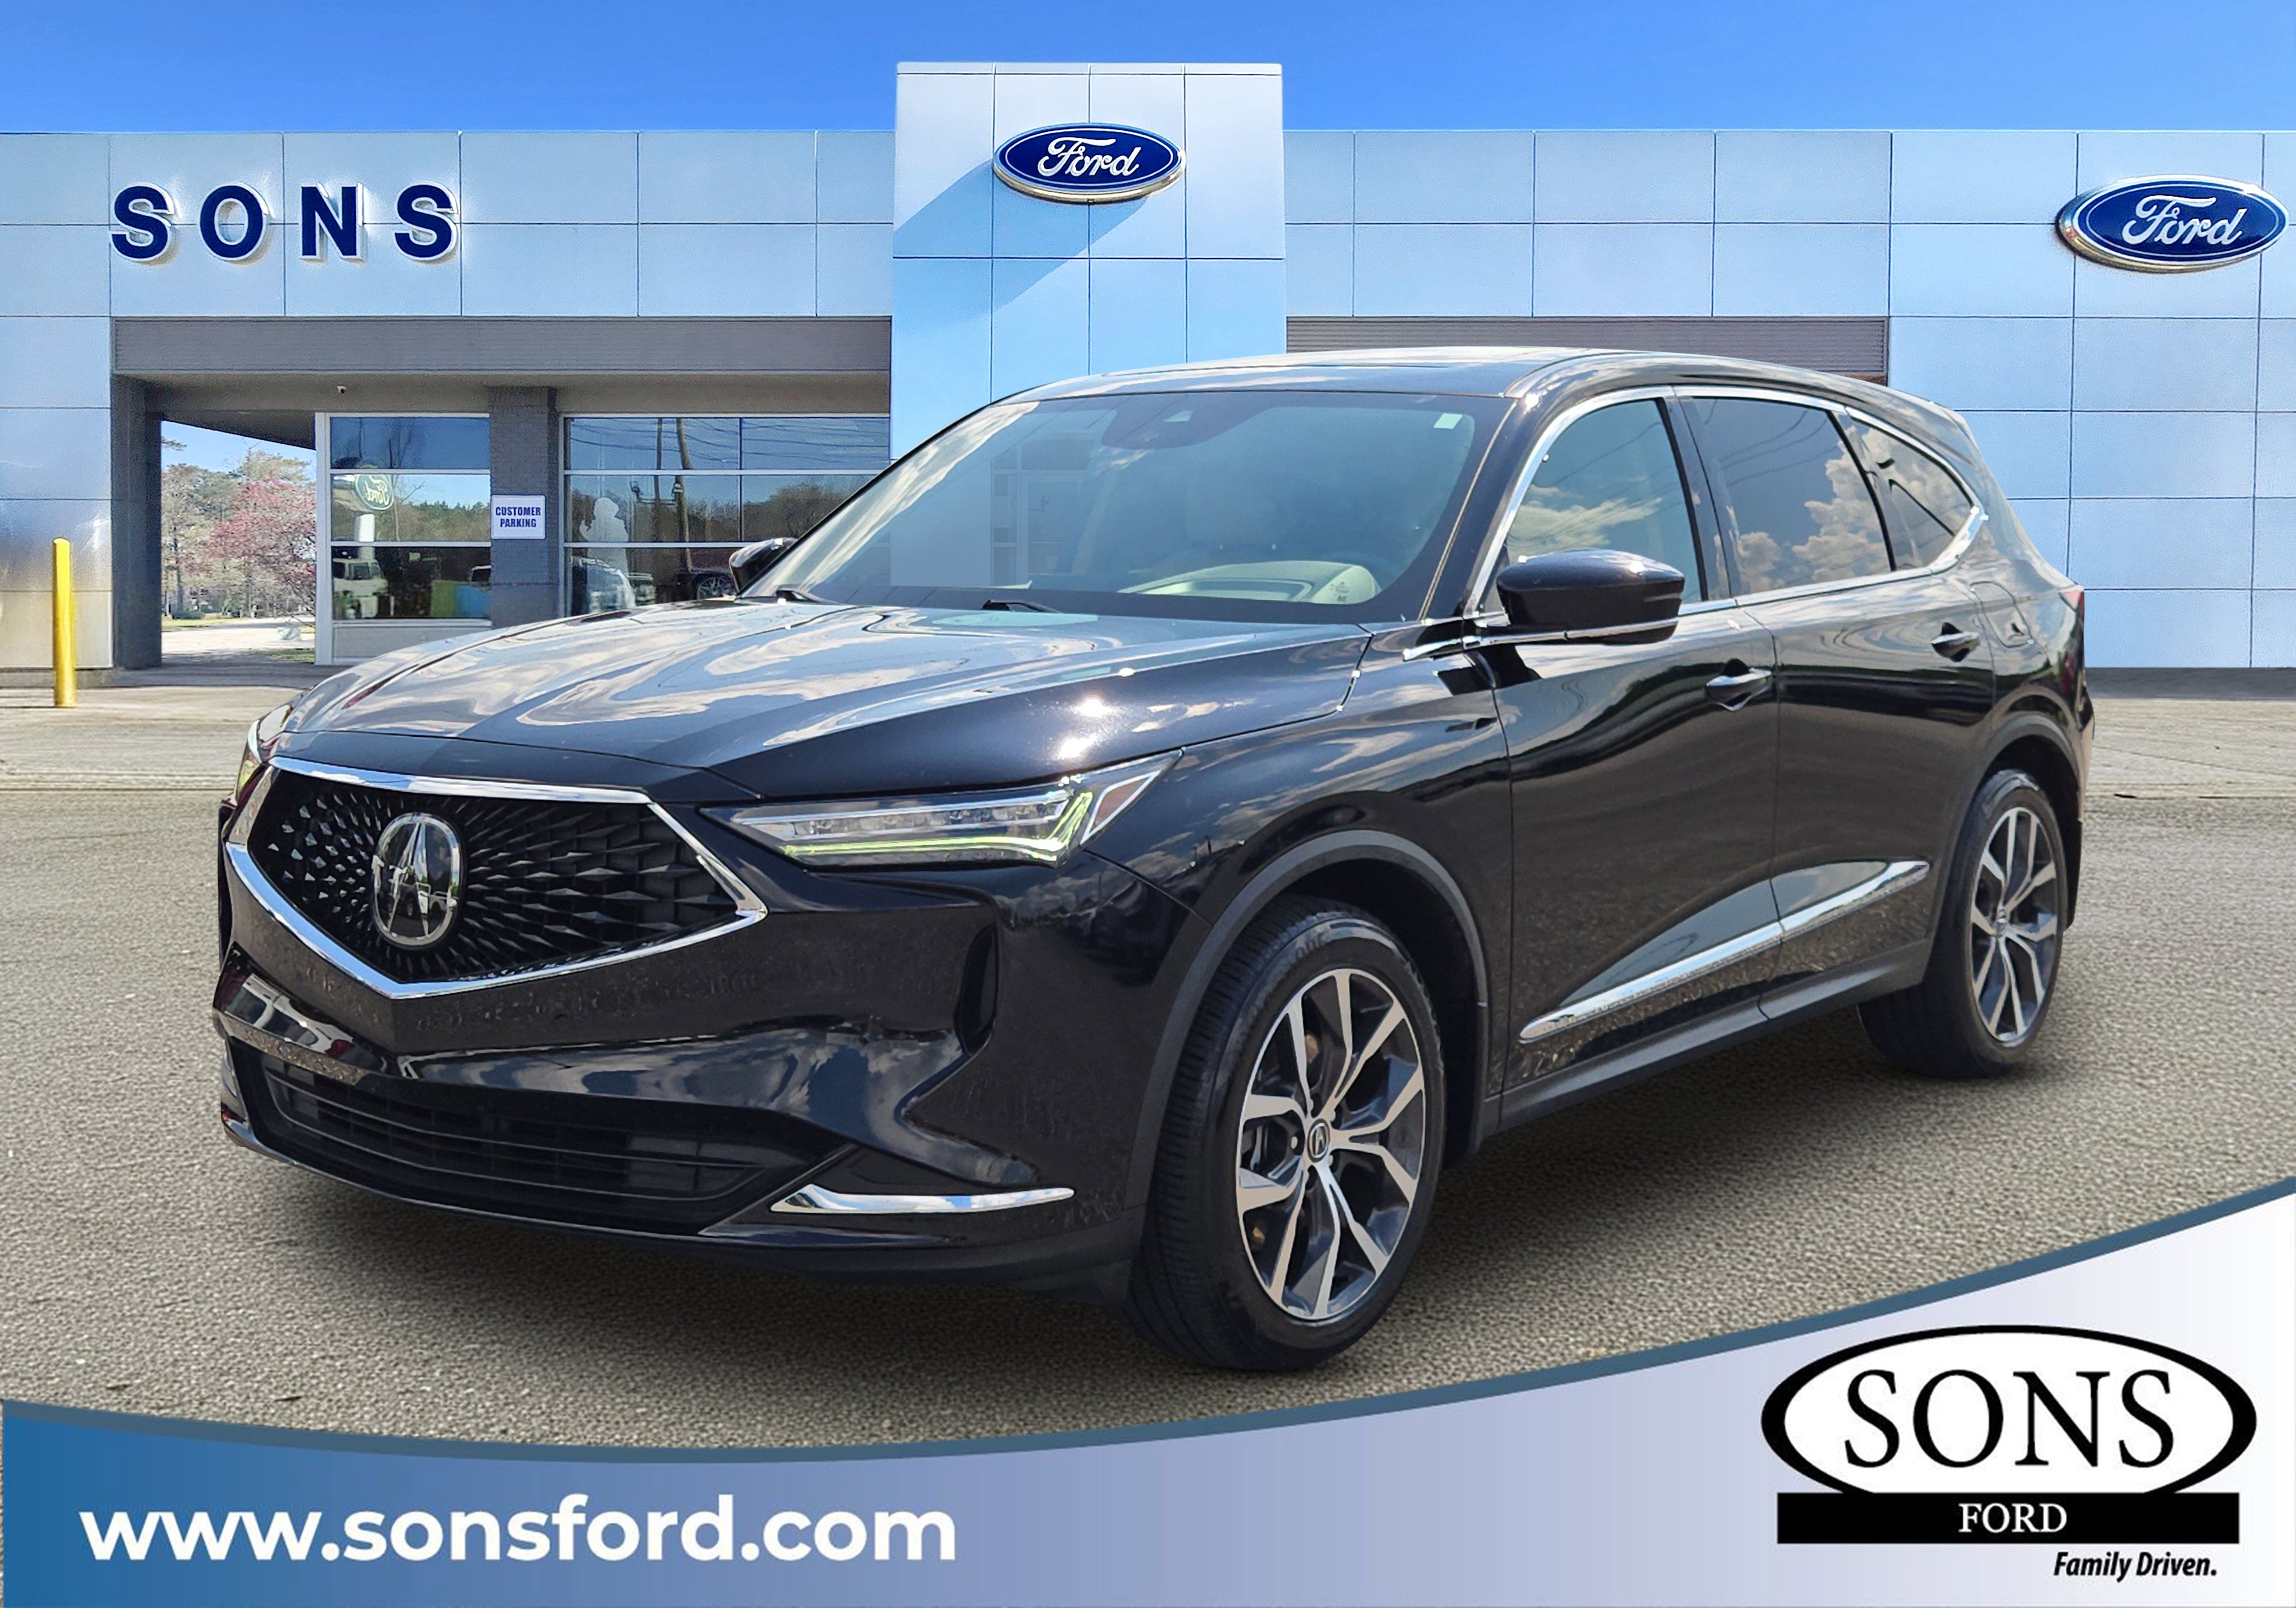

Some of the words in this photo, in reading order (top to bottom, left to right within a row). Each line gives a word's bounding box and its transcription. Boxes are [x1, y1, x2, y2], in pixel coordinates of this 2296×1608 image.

[1037, 137, 1142, 177] Ford
[111, 184, 457, 261] SONS
[2122, 195, 2247, 246] Ford
[495, 507, 541, 516] CUSTOMER
[500, 519, 537, 527] PARKING
